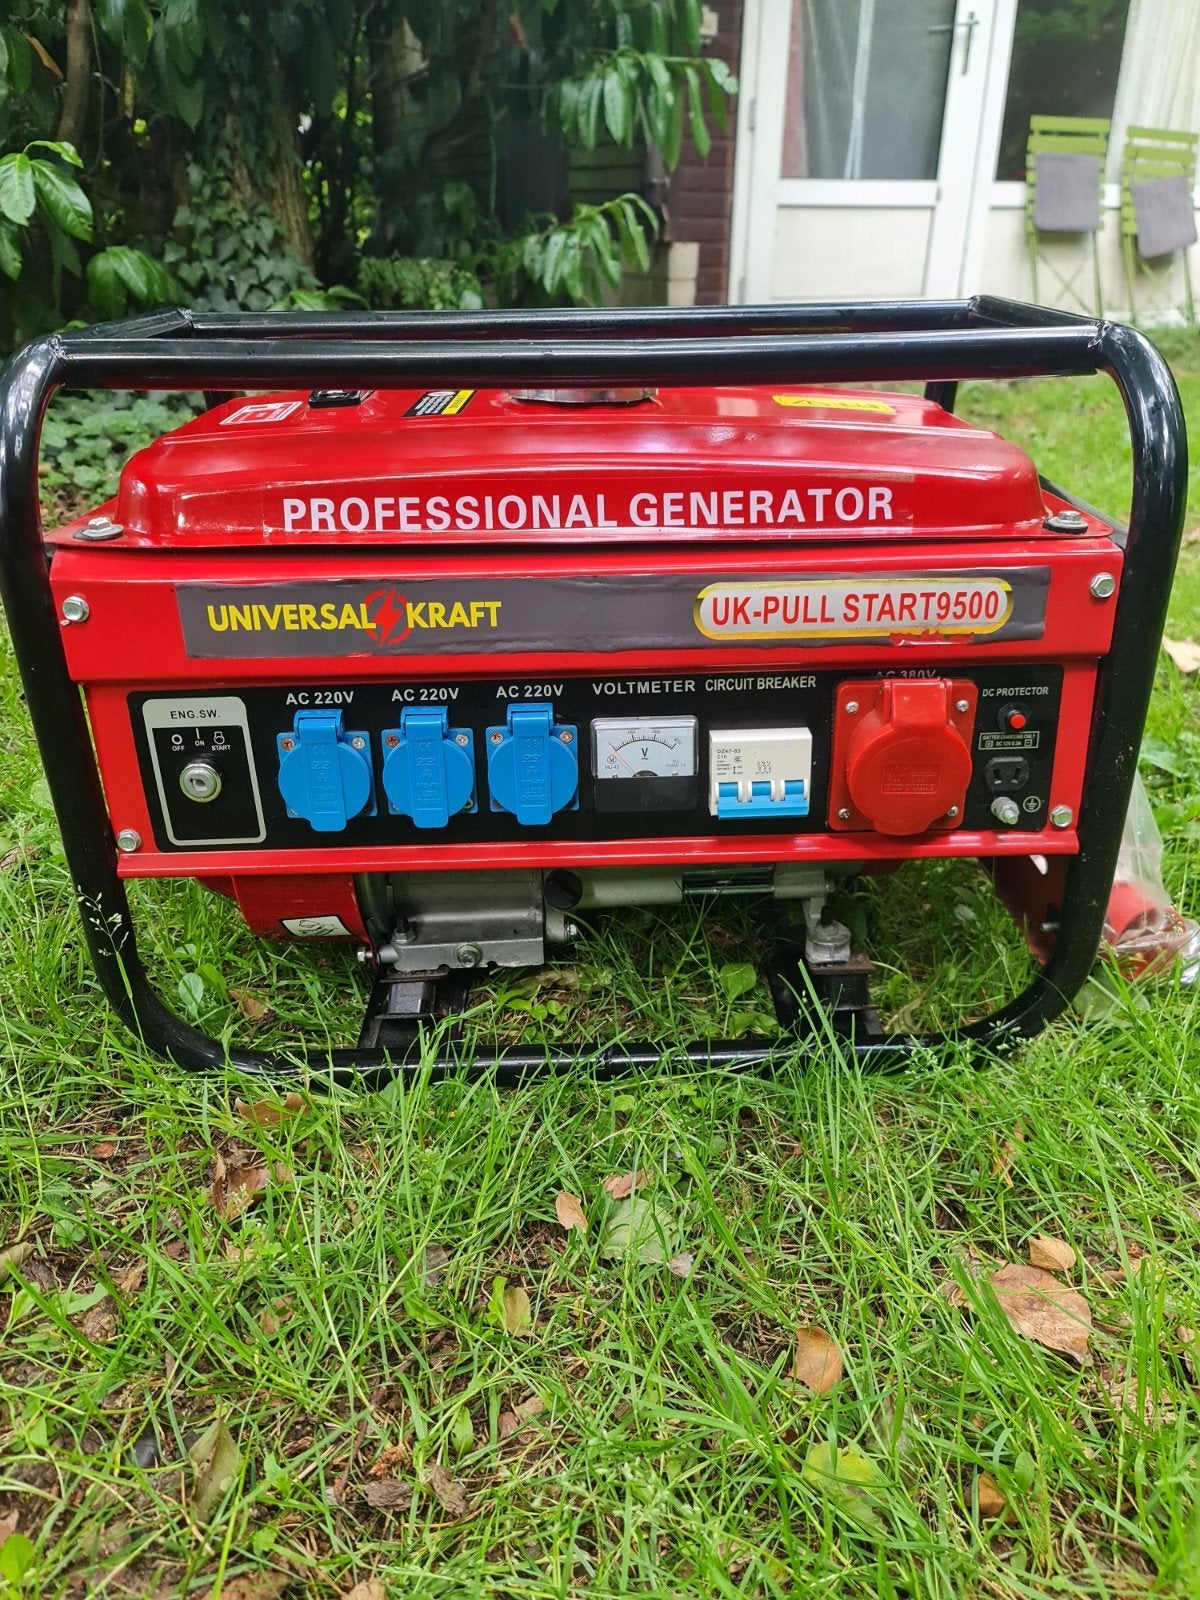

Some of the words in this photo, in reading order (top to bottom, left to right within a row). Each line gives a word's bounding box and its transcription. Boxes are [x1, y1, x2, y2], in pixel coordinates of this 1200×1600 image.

[283, 494, 618, 533] PROFESSIONAL
[629, 486, 894, 527] GENERATOR
[207, 603, 376, 631] UNIVERSAL
[406, 601, 502, 629] KRAFT
[712, 598, 836, 627] UK-PULL
[496, 685, 519, 699] AC
[523, 684, 564, 698] 220V
[592, 679, 696, 695] VOLTMETER
[705, 677, 754, 692] CIRCUIT
[757, 675, 816, 690] BREAKER
[982, 688, 995, 697] DC
[996, 686, 1049, 697] PROTECTOR
[286, 692, 309, 706] AC
[314, 690, 354, 705] 220V
[391, 688, 415, 702] AC
[419, 687, 459, 701] 220V
[170, 709, 221, 719] ENG.SW.
[641, 747, 649, 758] V
